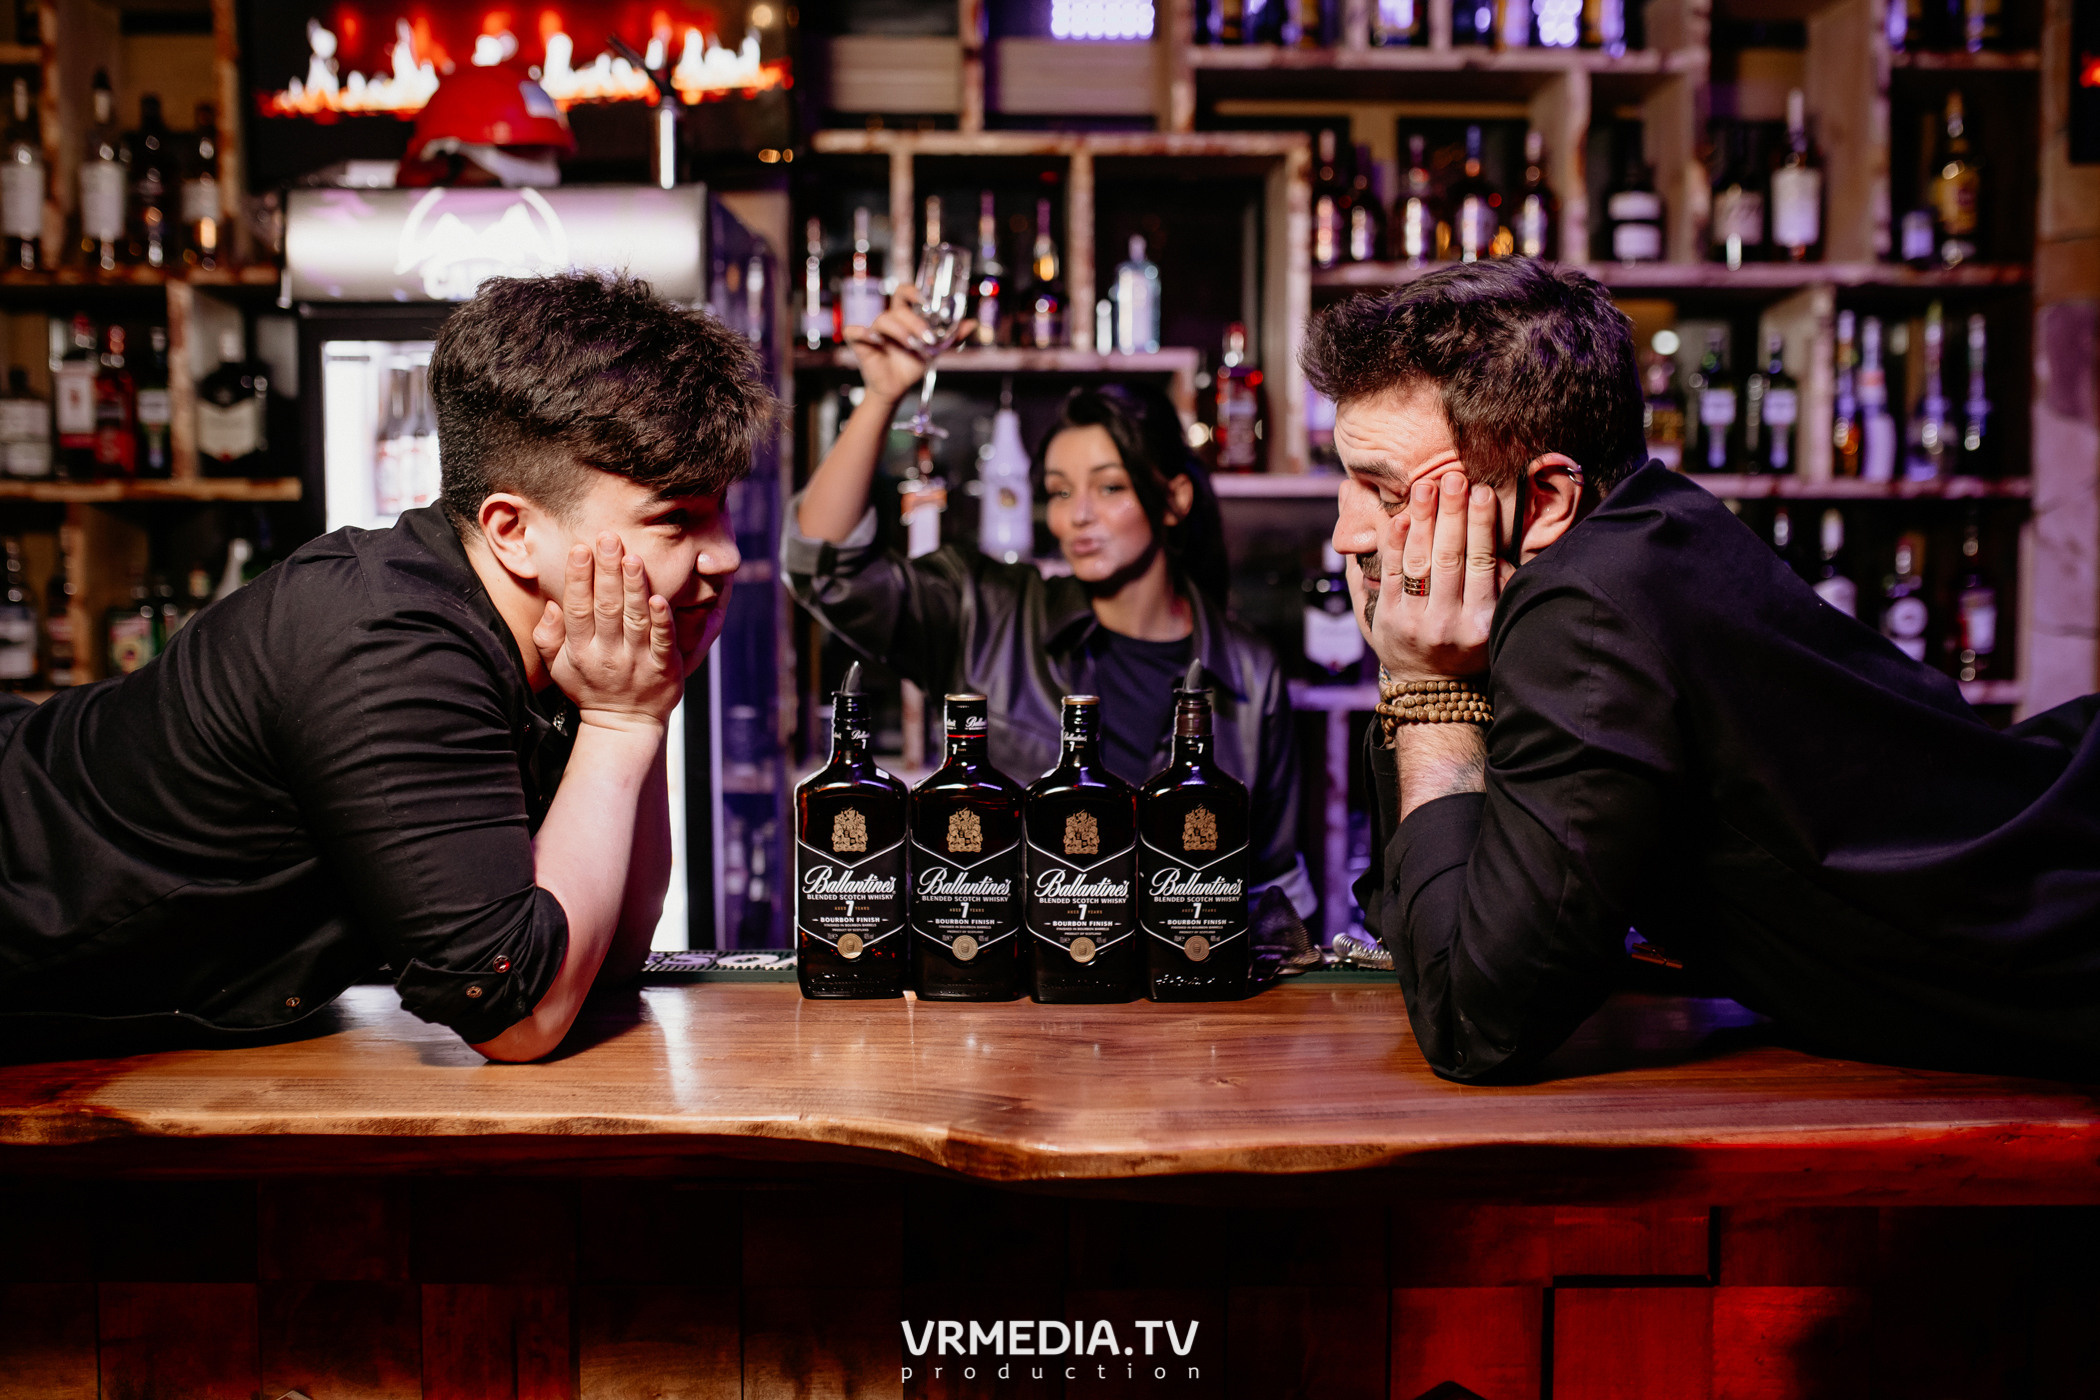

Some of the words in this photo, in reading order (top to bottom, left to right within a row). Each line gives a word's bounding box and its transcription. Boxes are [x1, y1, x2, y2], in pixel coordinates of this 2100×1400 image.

[802, 865, 896, 893] Ballantine's
[917, 867, 1011, 895] Ballantine's
[1034, 869, 1129, 897] Ballantine's
[1149, 868, 1243, 896] Ballantine's
[846, 901, 854, 916] 7
[961, 903, 969, 918] 7
[1078, 904, 1087, 920] 7
[1193, 903, 1202, 918] 7
